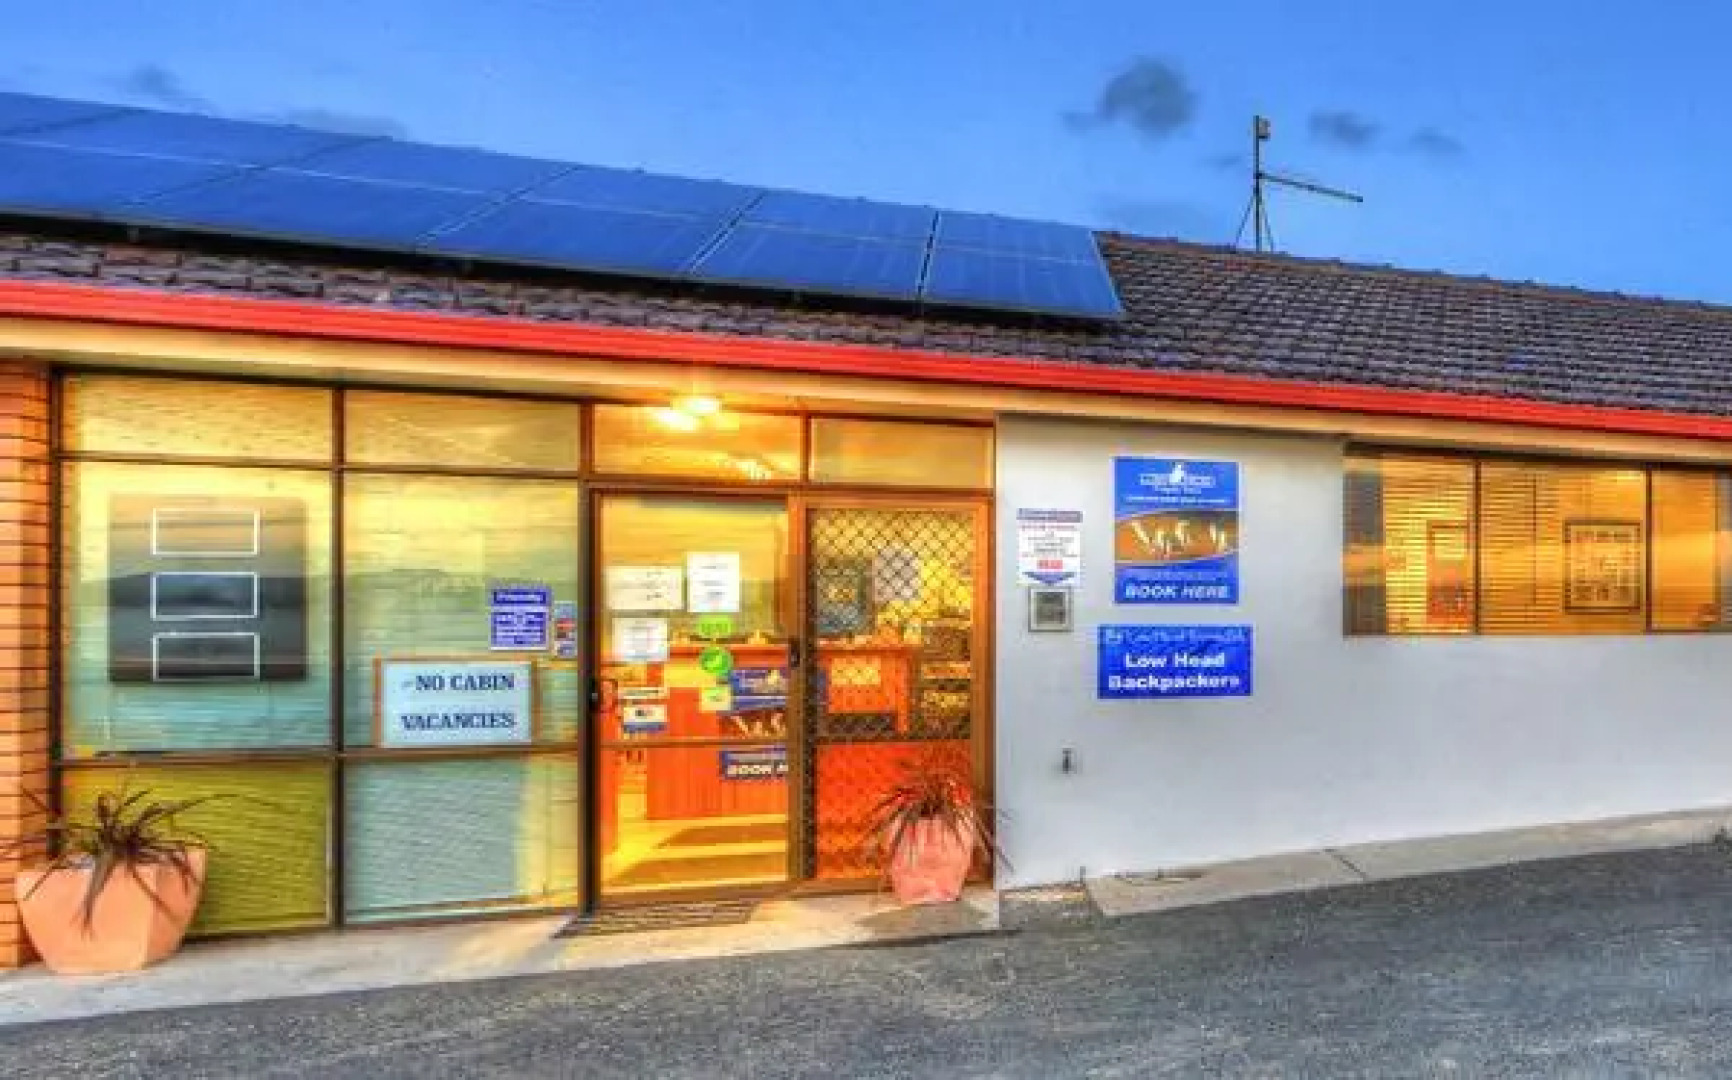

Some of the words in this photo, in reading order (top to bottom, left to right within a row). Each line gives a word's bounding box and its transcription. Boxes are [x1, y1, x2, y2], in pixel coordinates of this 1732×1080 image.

[1125, 583, 1176, 599] BOOK
[1183, 584, 1229, 599] HERE
[1125, 652, 1167, 668] Low
[1174, 652, 1225, 668] Head
[415, 673, 445, 691] NO
[450, 672, 515, 691] CABIN
[1108, 673, 1240, 693] Backpackers
[401, 713, 516, 731] VACANCIES
